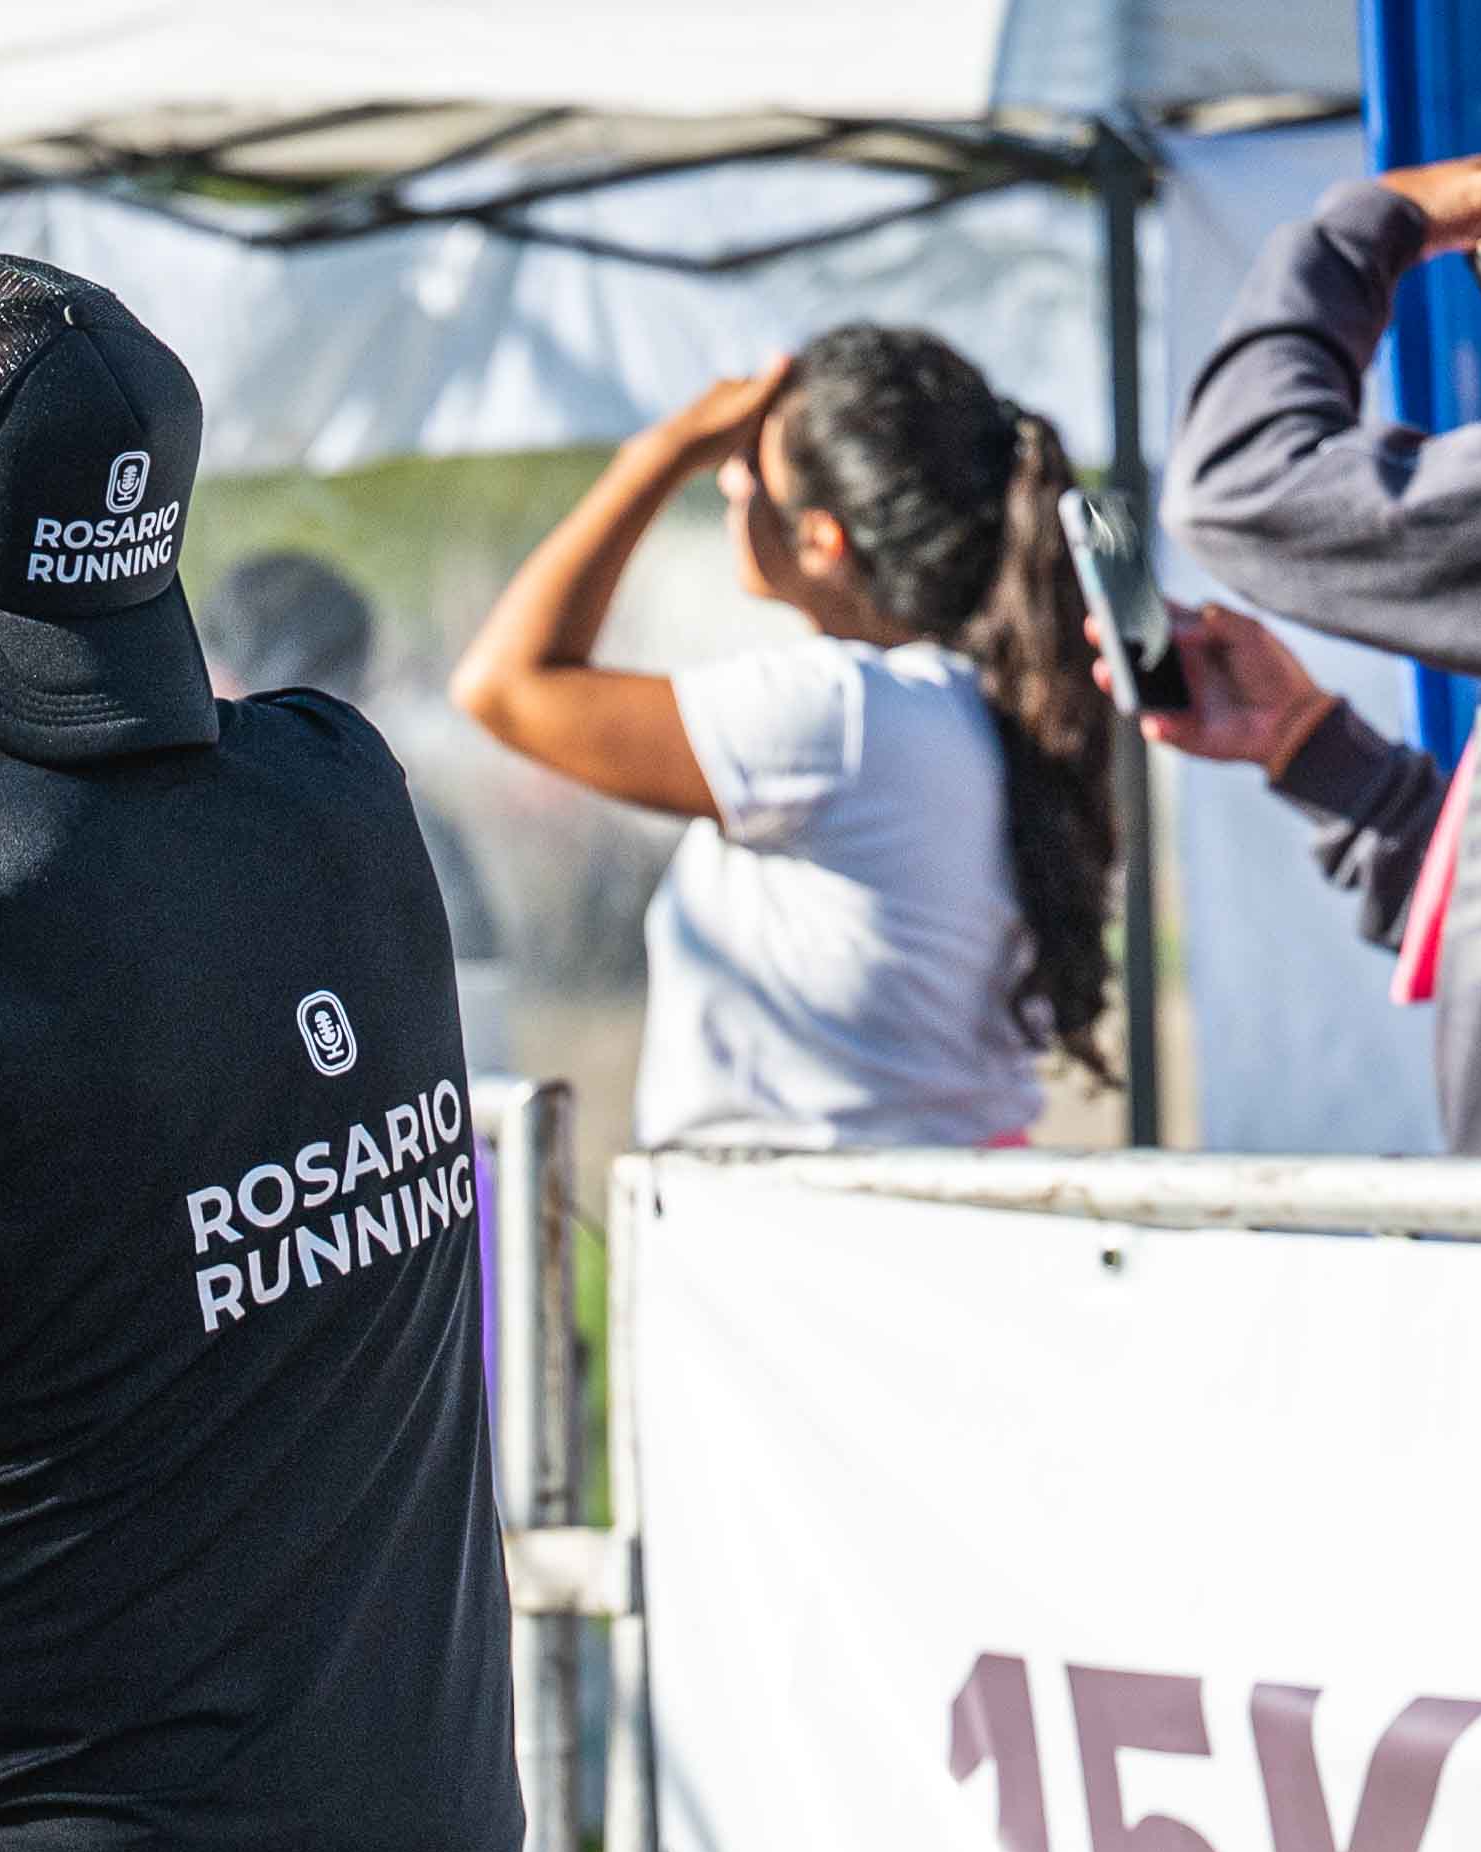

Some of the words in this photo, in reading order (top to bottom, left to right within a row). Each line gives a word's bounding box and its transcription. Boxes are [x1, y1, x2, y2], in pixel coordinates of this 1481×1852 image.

[27, 534, 173, 584] RUNNING
[34, 501, 179, 549] ROSARIO
[186, 1079, 461, 1255] ROSARIO
[196, 1154, 473, 1333] RUNNING
